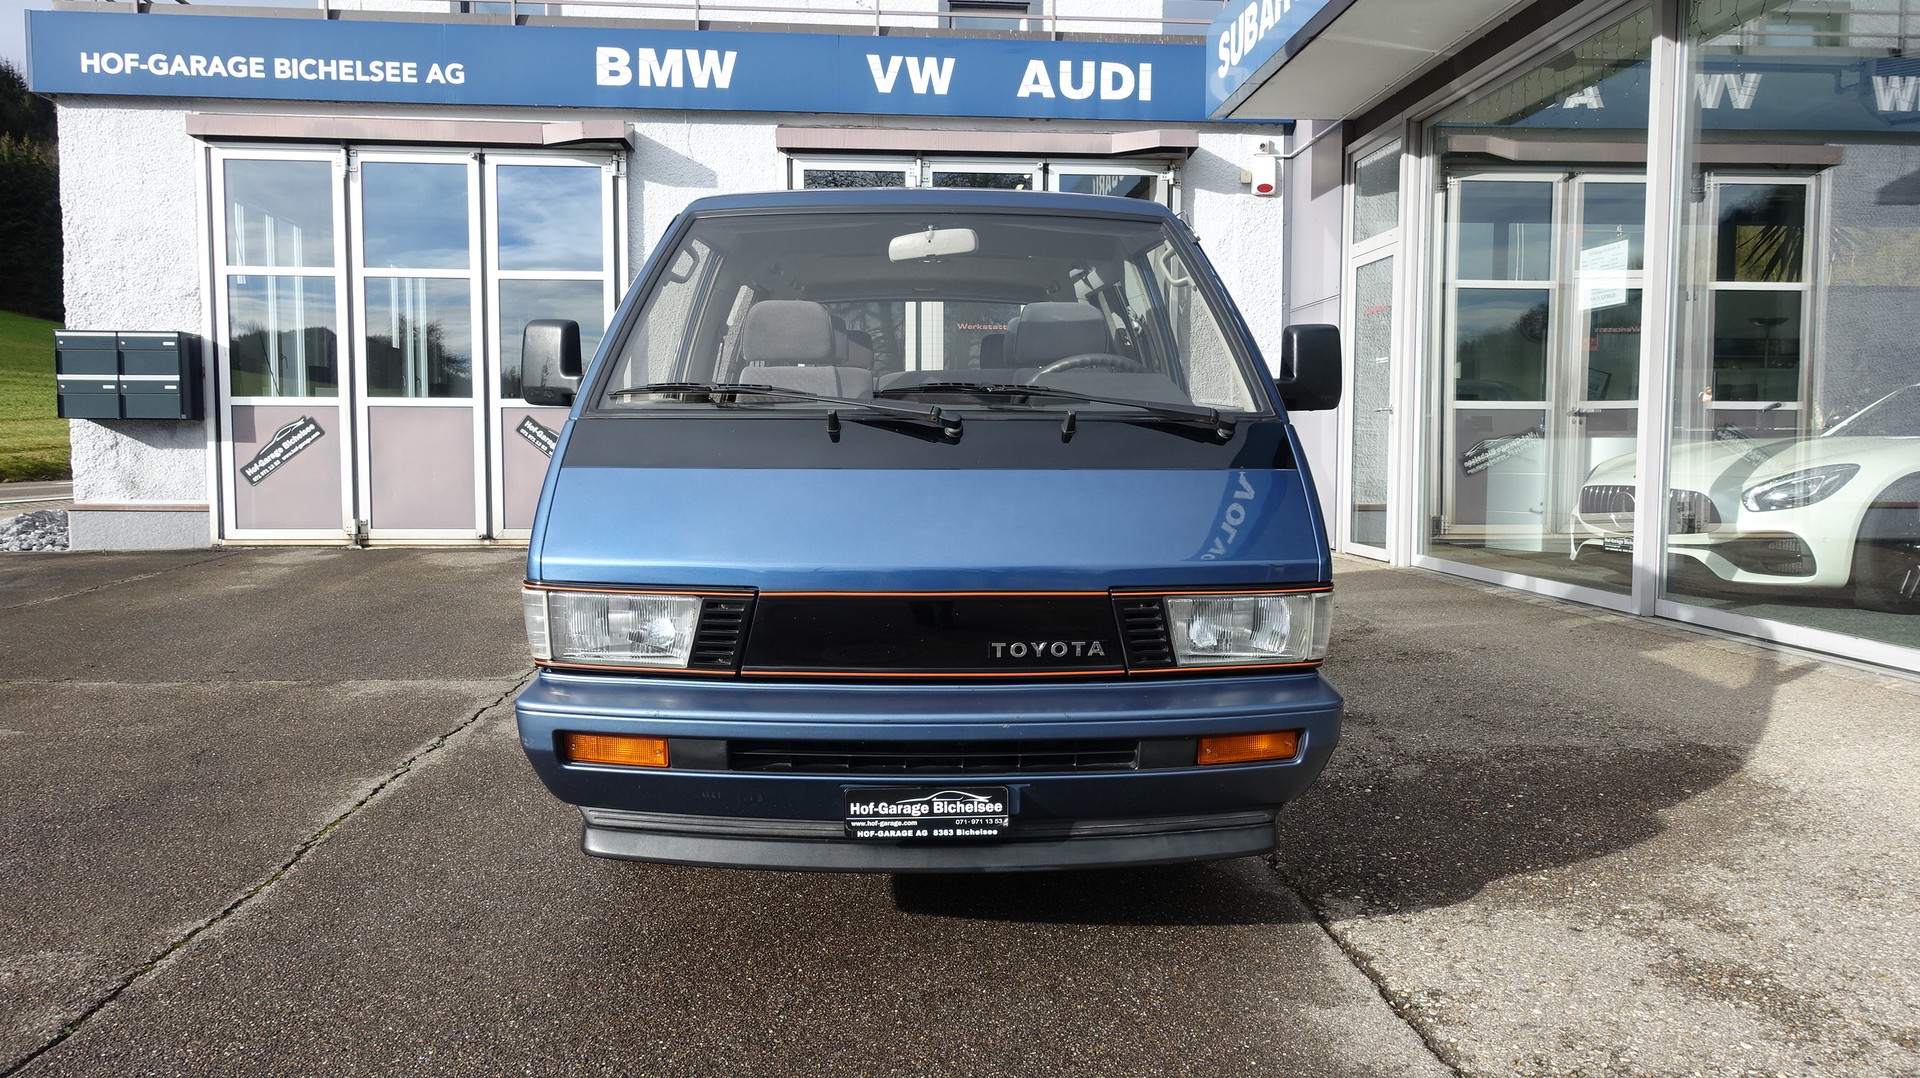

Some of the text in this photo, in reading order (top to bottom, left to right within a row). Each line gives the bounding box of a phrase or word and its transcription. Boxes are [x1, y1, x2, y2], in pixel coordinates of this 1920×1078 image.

[1217, 0, 1291, 79] SUBA
[80, 51, 465, 85] HOF-GARAGE BICHELSEE AG
[595, 46, 738, 89] BMW
[865, 54, 956, 95] VW
[1016, 59, 1152, 101] AUDI
[245, 424, 316, 476] Hof-Garage Bichelsee
[524, 420, 556, 449] Hof-Garag
[991, 640, 1106, 658] TOYOTA
[850, 801, 1003, 817] Hof-Garage Bichelsee
[857, 828, 998, 838] HOF-GARAGE AG 8363 Bichelsee
